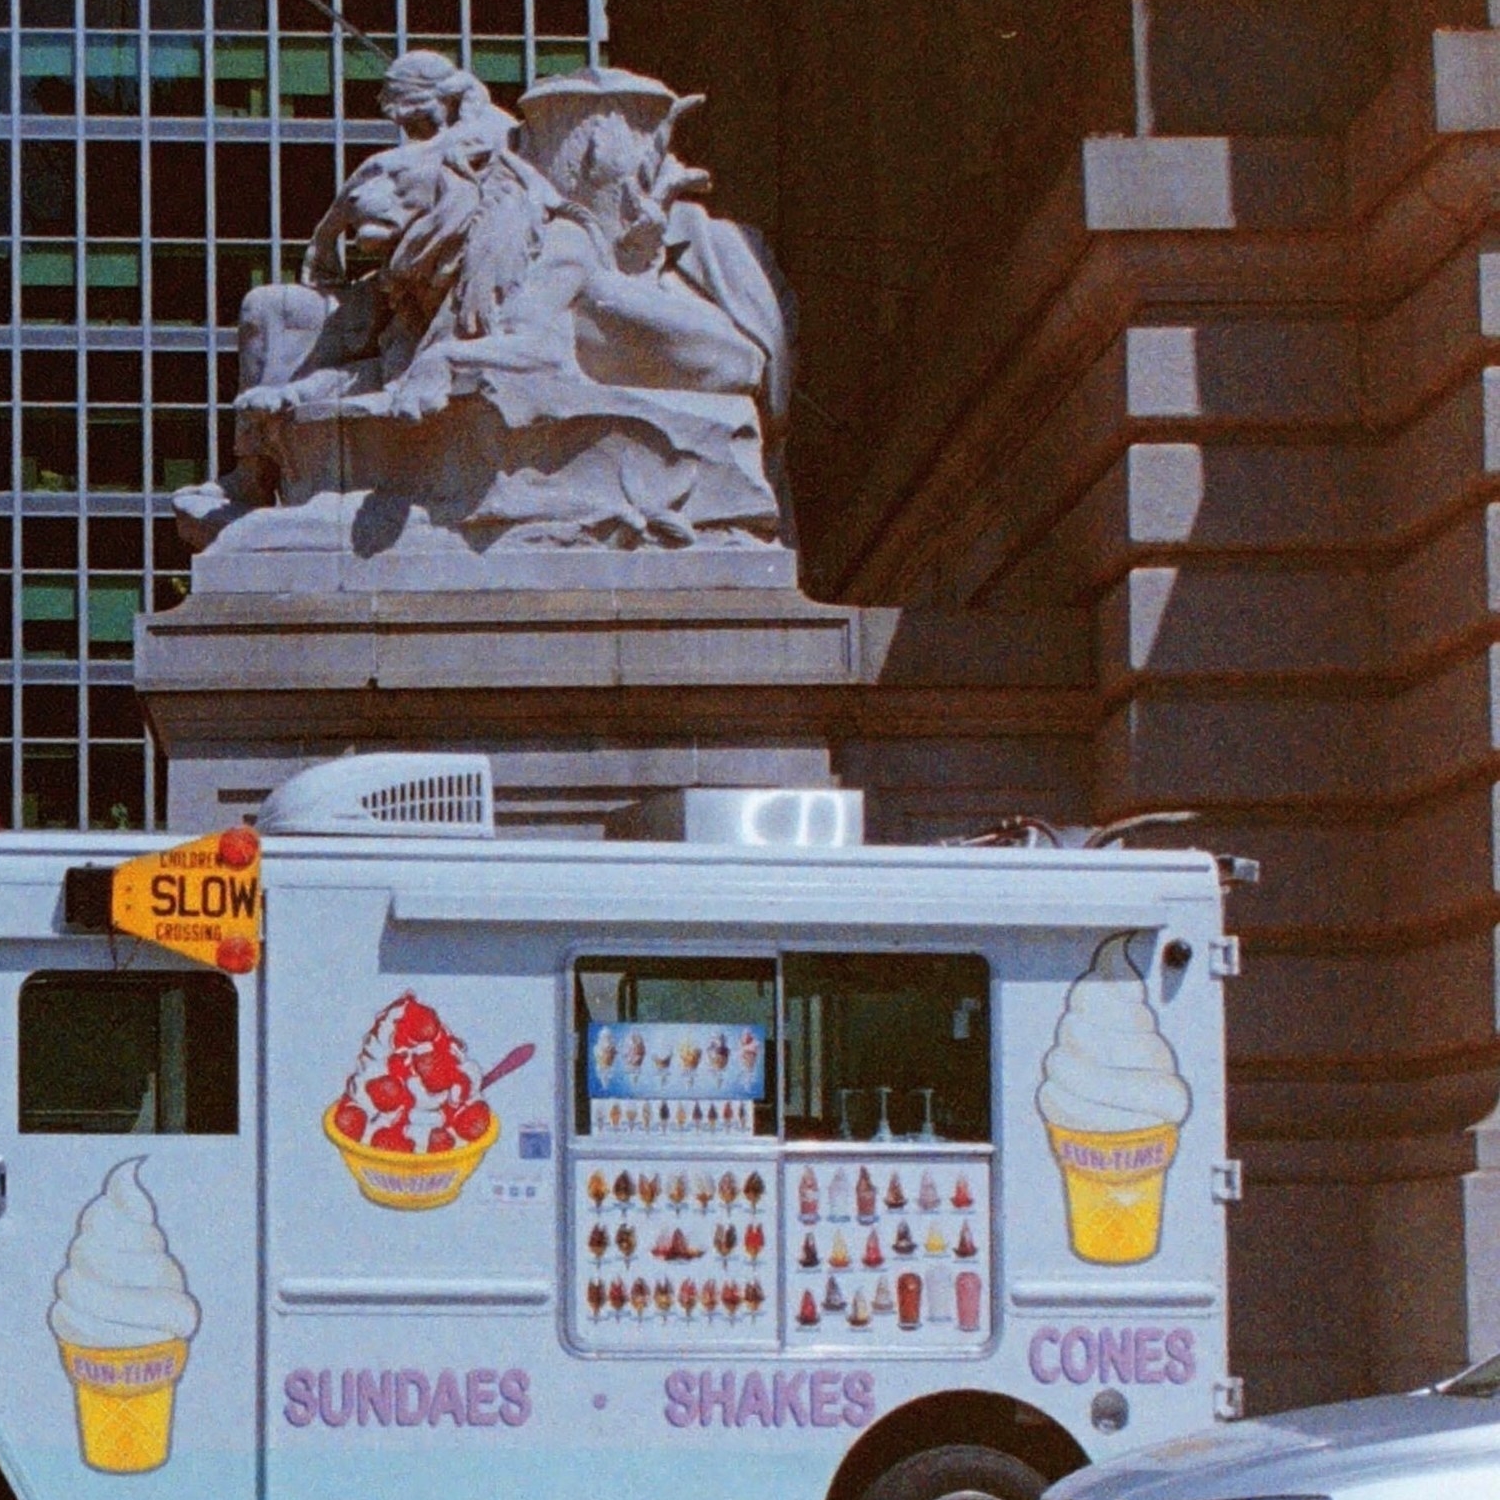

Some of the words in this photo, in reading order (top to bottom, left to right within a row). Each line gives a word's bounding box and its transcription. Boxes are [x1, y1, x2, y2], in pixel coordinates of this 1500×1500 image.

[151, 874, 258, 919] SLOW
[156, 923, 223, 942] CROSSING
[1028, 1325, 1196, 1385] CONES
[284, 1367, 532, 1427] SUNDAES
[664, 1368, 876, 1428] SHAKES
